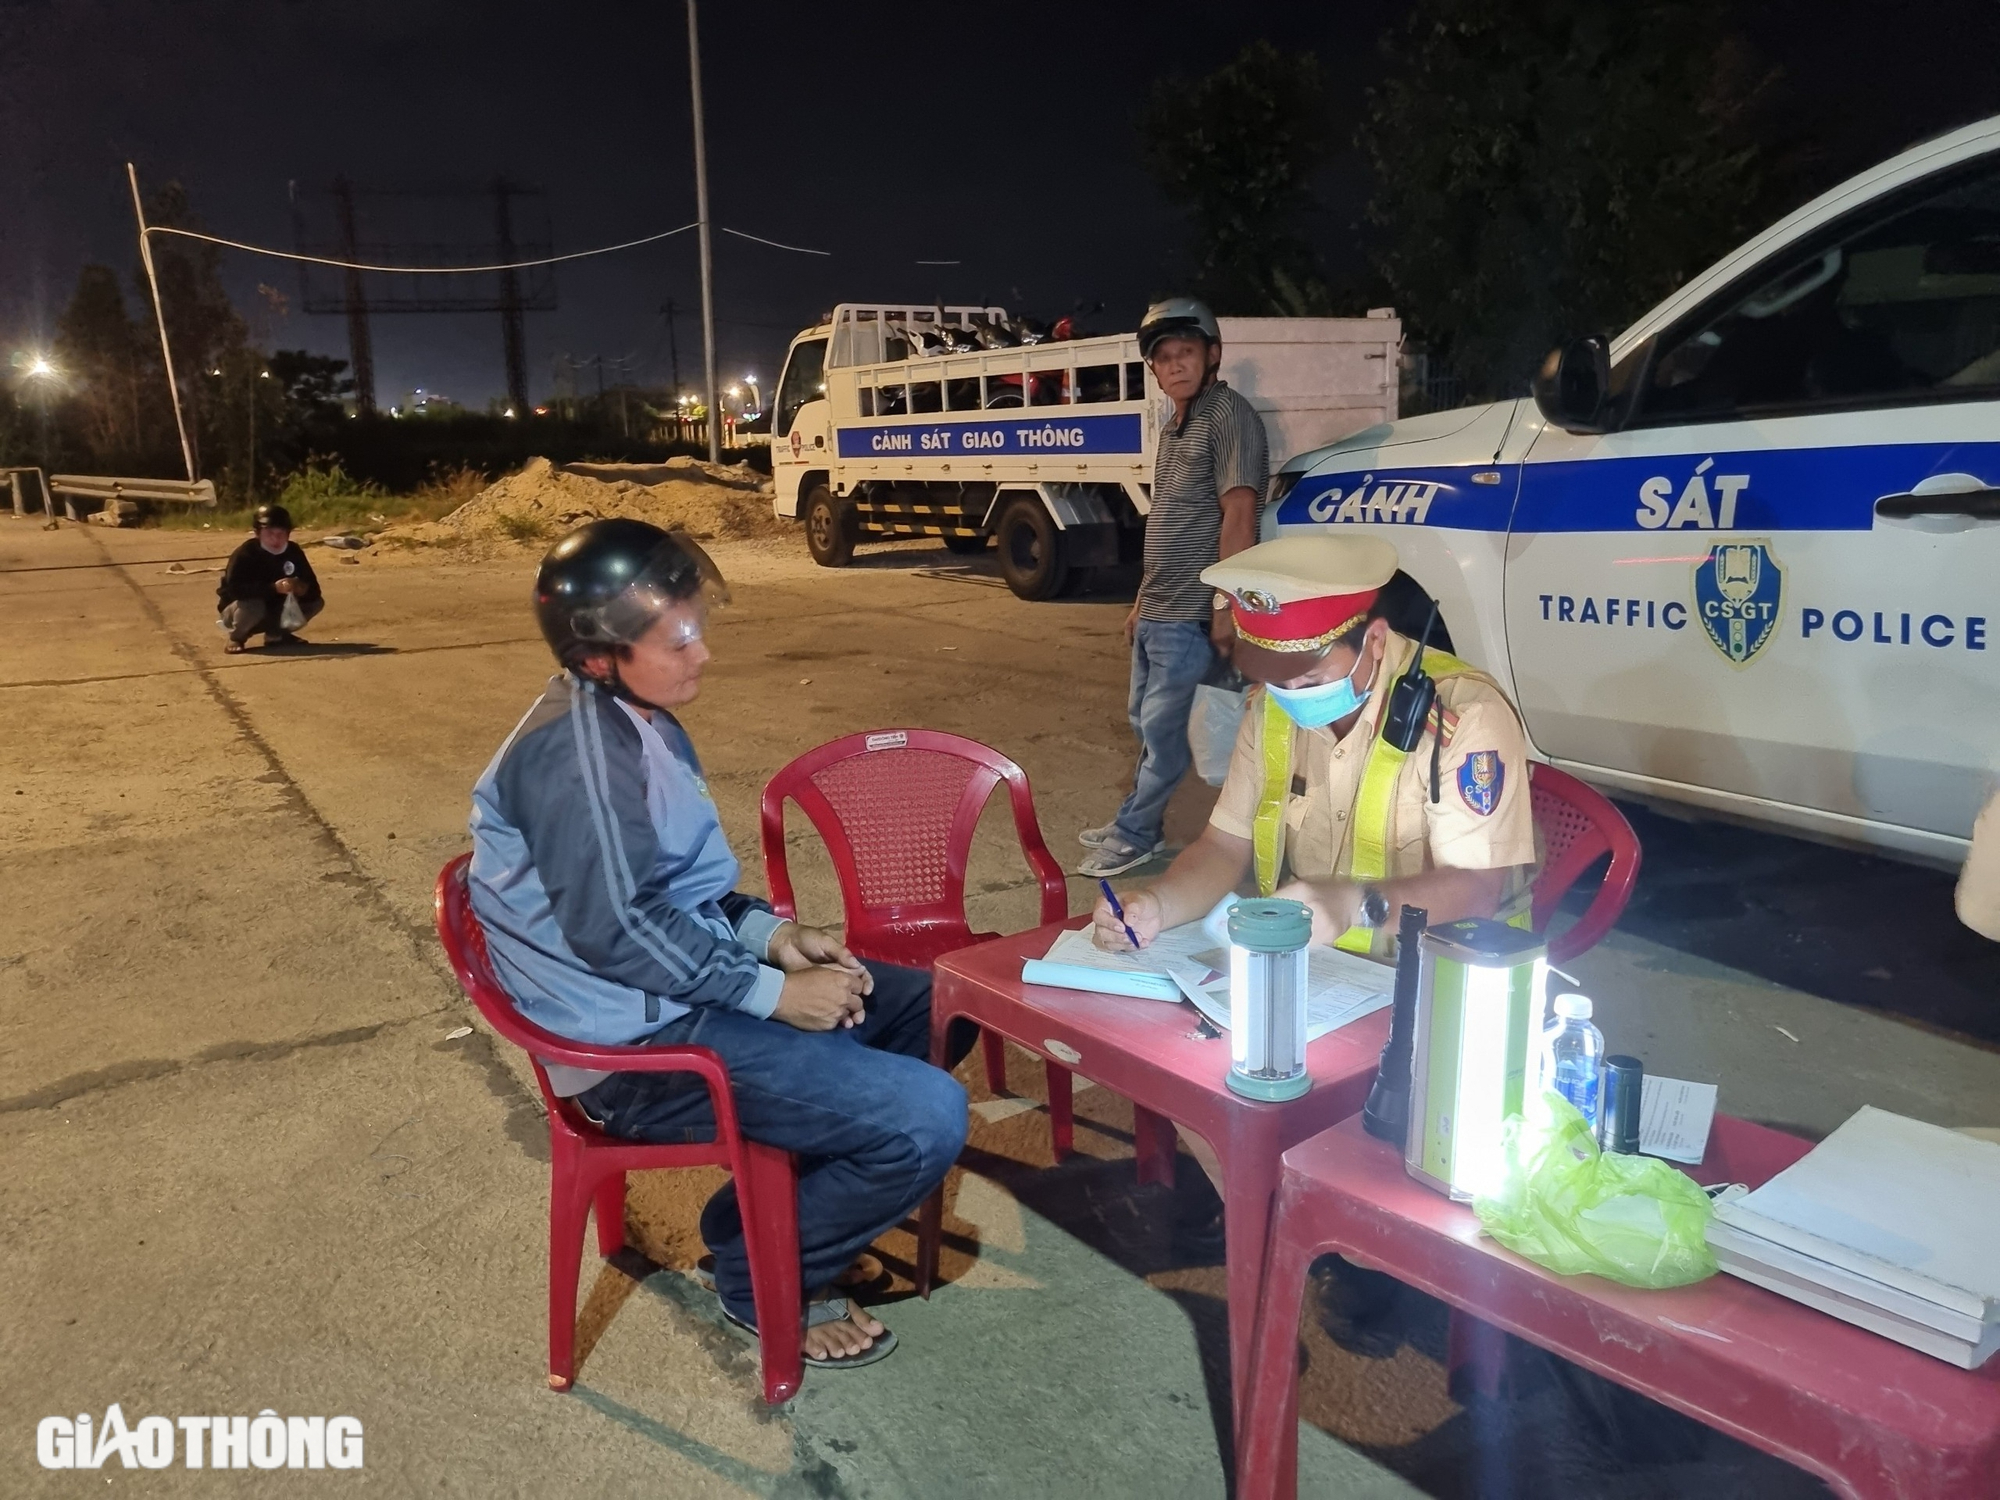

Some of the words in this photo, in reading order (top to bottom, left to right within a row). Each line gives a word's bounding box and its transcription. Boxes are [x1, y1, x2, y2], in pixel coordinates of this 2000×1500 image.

[871, 429, 912, 451] CẢNH
[920, 428, 952, 450] SÁT
[962, 430, 1005, 449] GIAO
[1016, 423, 1085, 447] THÔNG
[1308, 473, 1439, 523] CẢNH
[1635, 456, 1751, 529] SÁT
[1539, 594, 1688, 631] TRAFFIC
[1704, 600, 1773, 620] CSGT
[1801, 607, 1987, 651] POLICE
